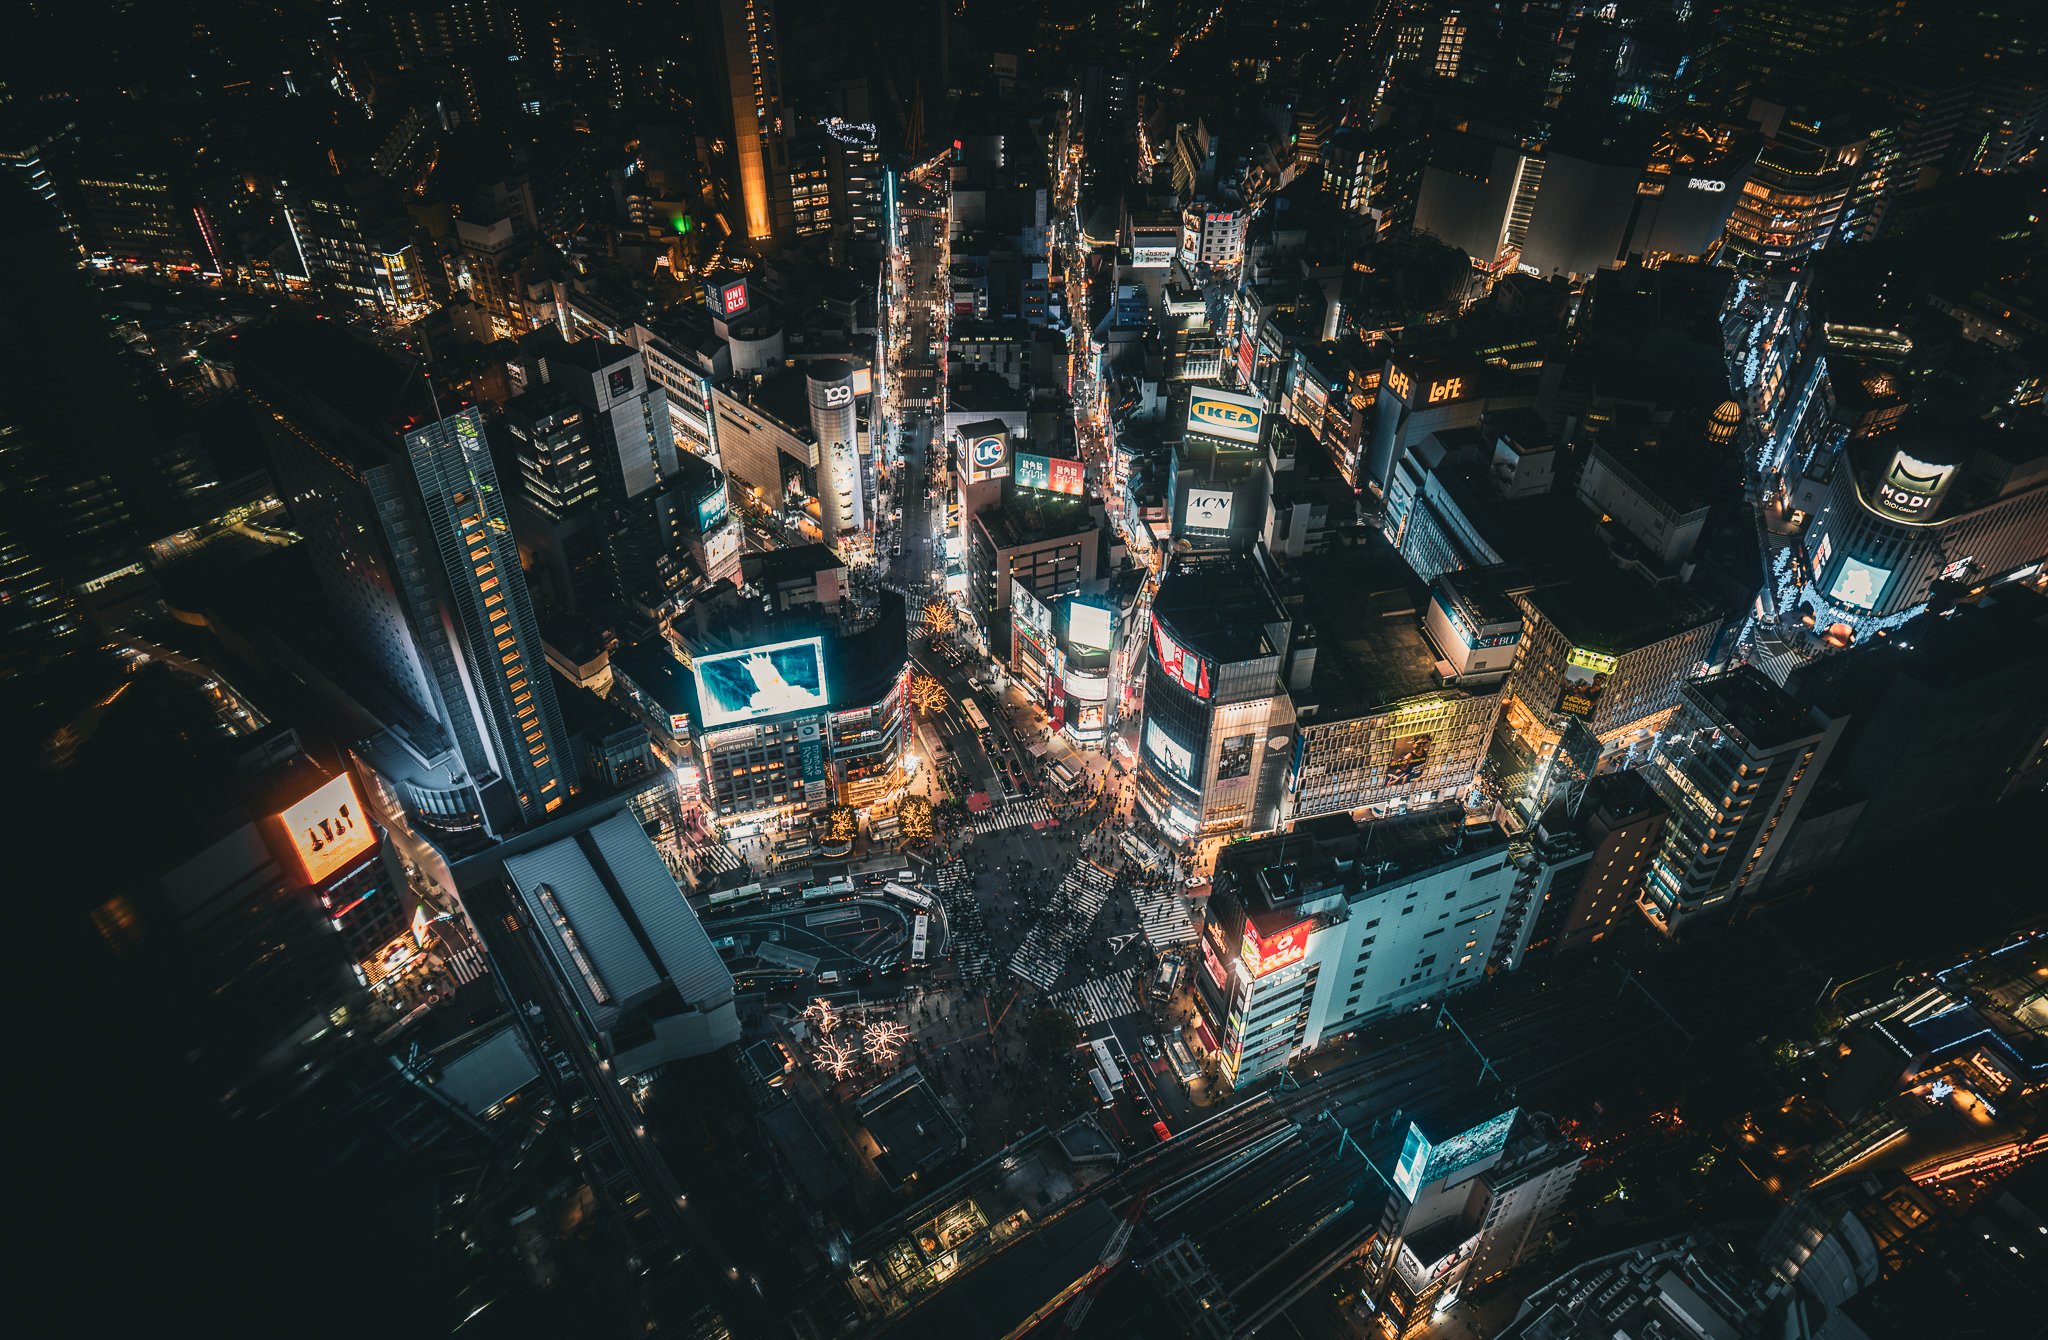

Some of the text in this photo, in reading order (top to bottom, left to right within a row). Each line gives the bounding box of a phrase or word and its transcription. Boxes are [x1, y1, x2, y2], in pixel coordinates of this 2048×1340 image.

[1688, 178, 1726, 192] PARCO
[726, 287, 742, 301] UNI
[727, 297, 744, 311] QLO
[824, 385, 850, 403] 109
[1198, 404, 1253, 425] IKEA
[1190, 496, 1231, 509] ACN
[1881, 484, 1932, 509] MODI
[1829, 607, 1858, 623] MODI
[1478, 635, 1515, 648] SEIBU
